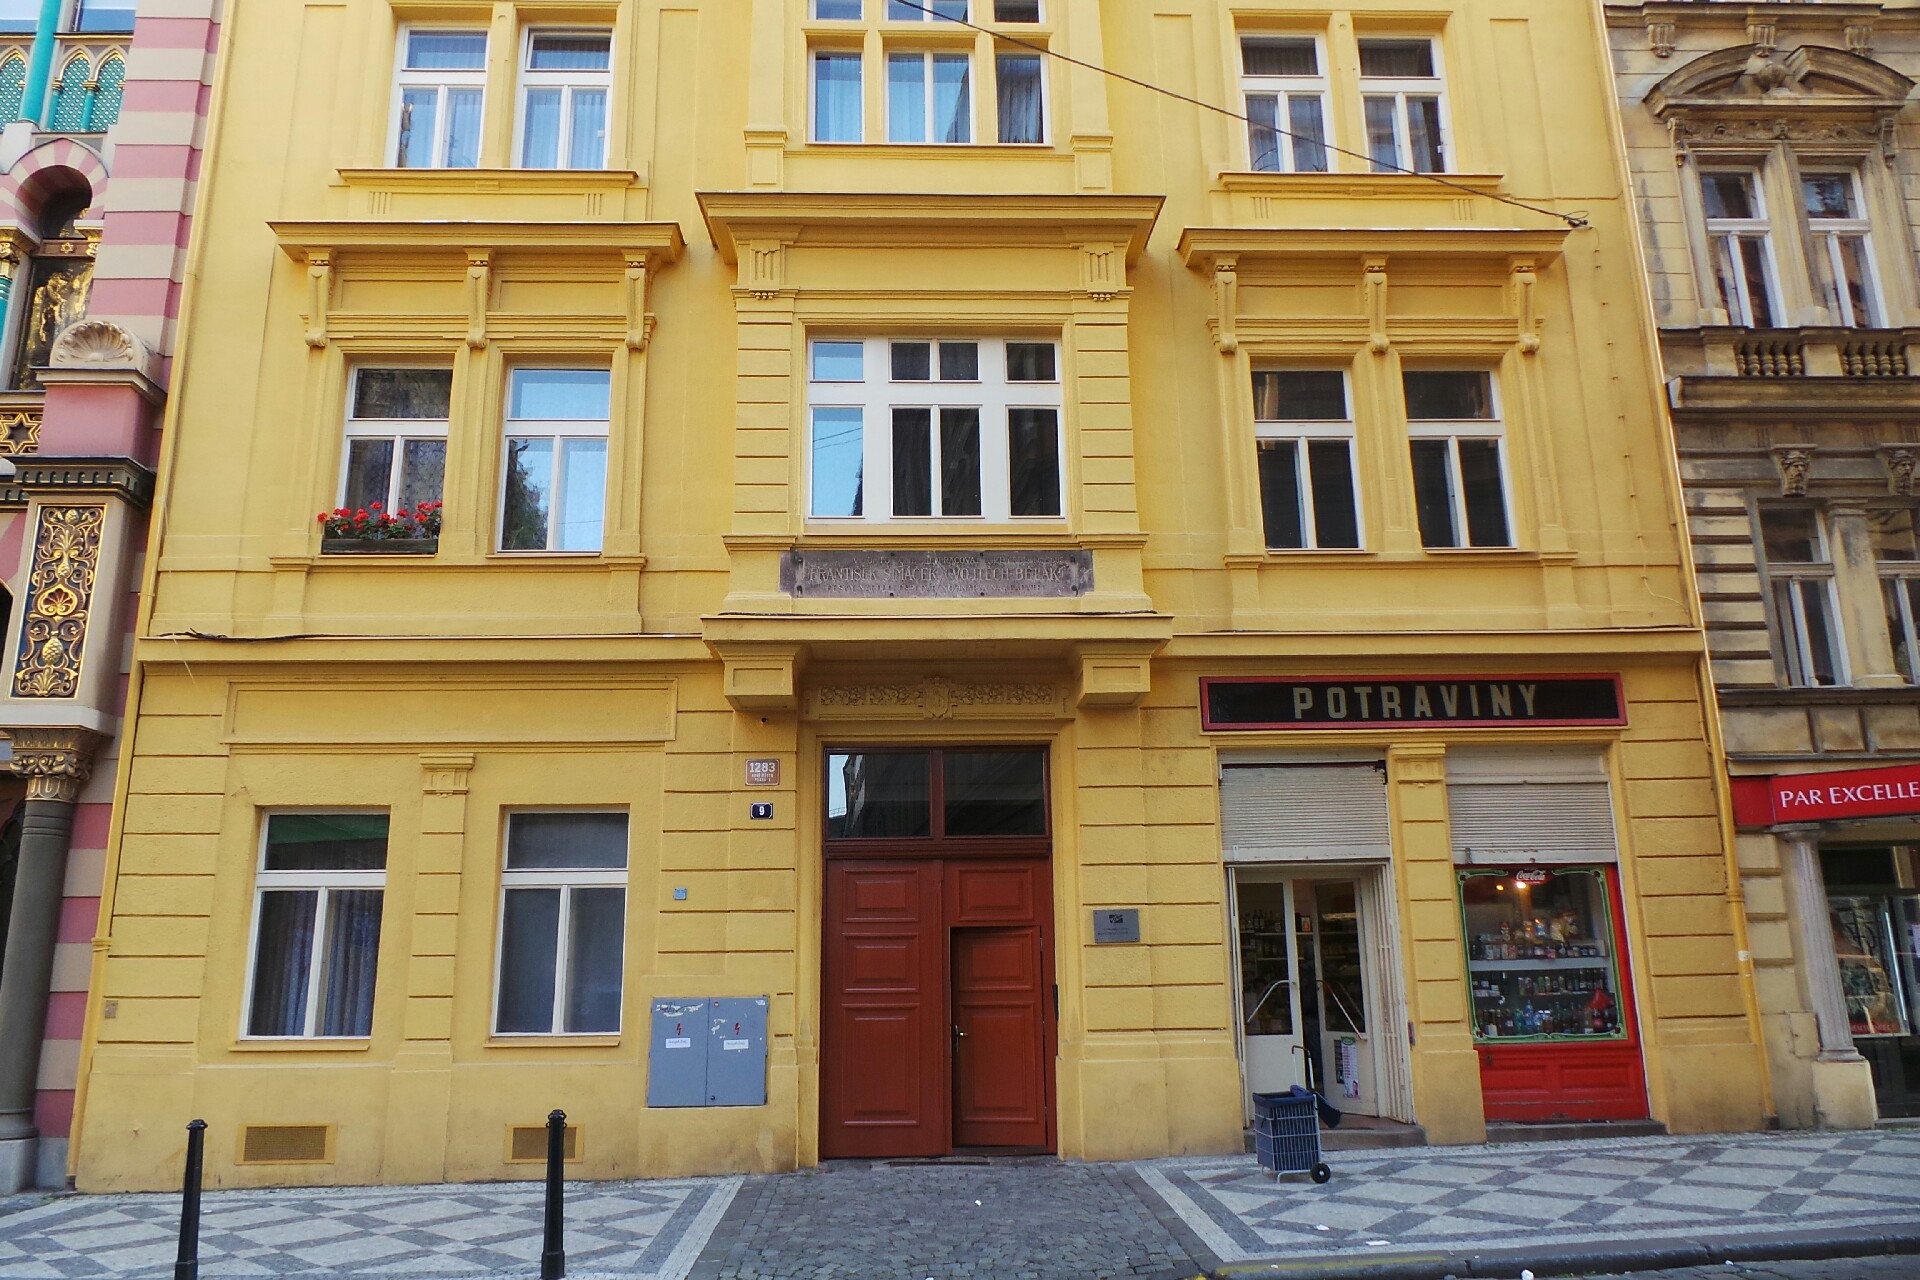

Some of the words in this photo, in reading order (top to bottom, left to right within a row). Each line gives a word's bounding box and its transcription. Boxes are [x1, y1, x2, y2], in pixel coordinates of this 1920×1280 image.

[1293, 684, 1537, 719] POTRAVINY
[749, 762, 776, 773] 1283
[1780, 790, 1824, 808] PAR
[1829, 781, 1920, 804] EXCELLE
[759, 806, 765, 816] 9
